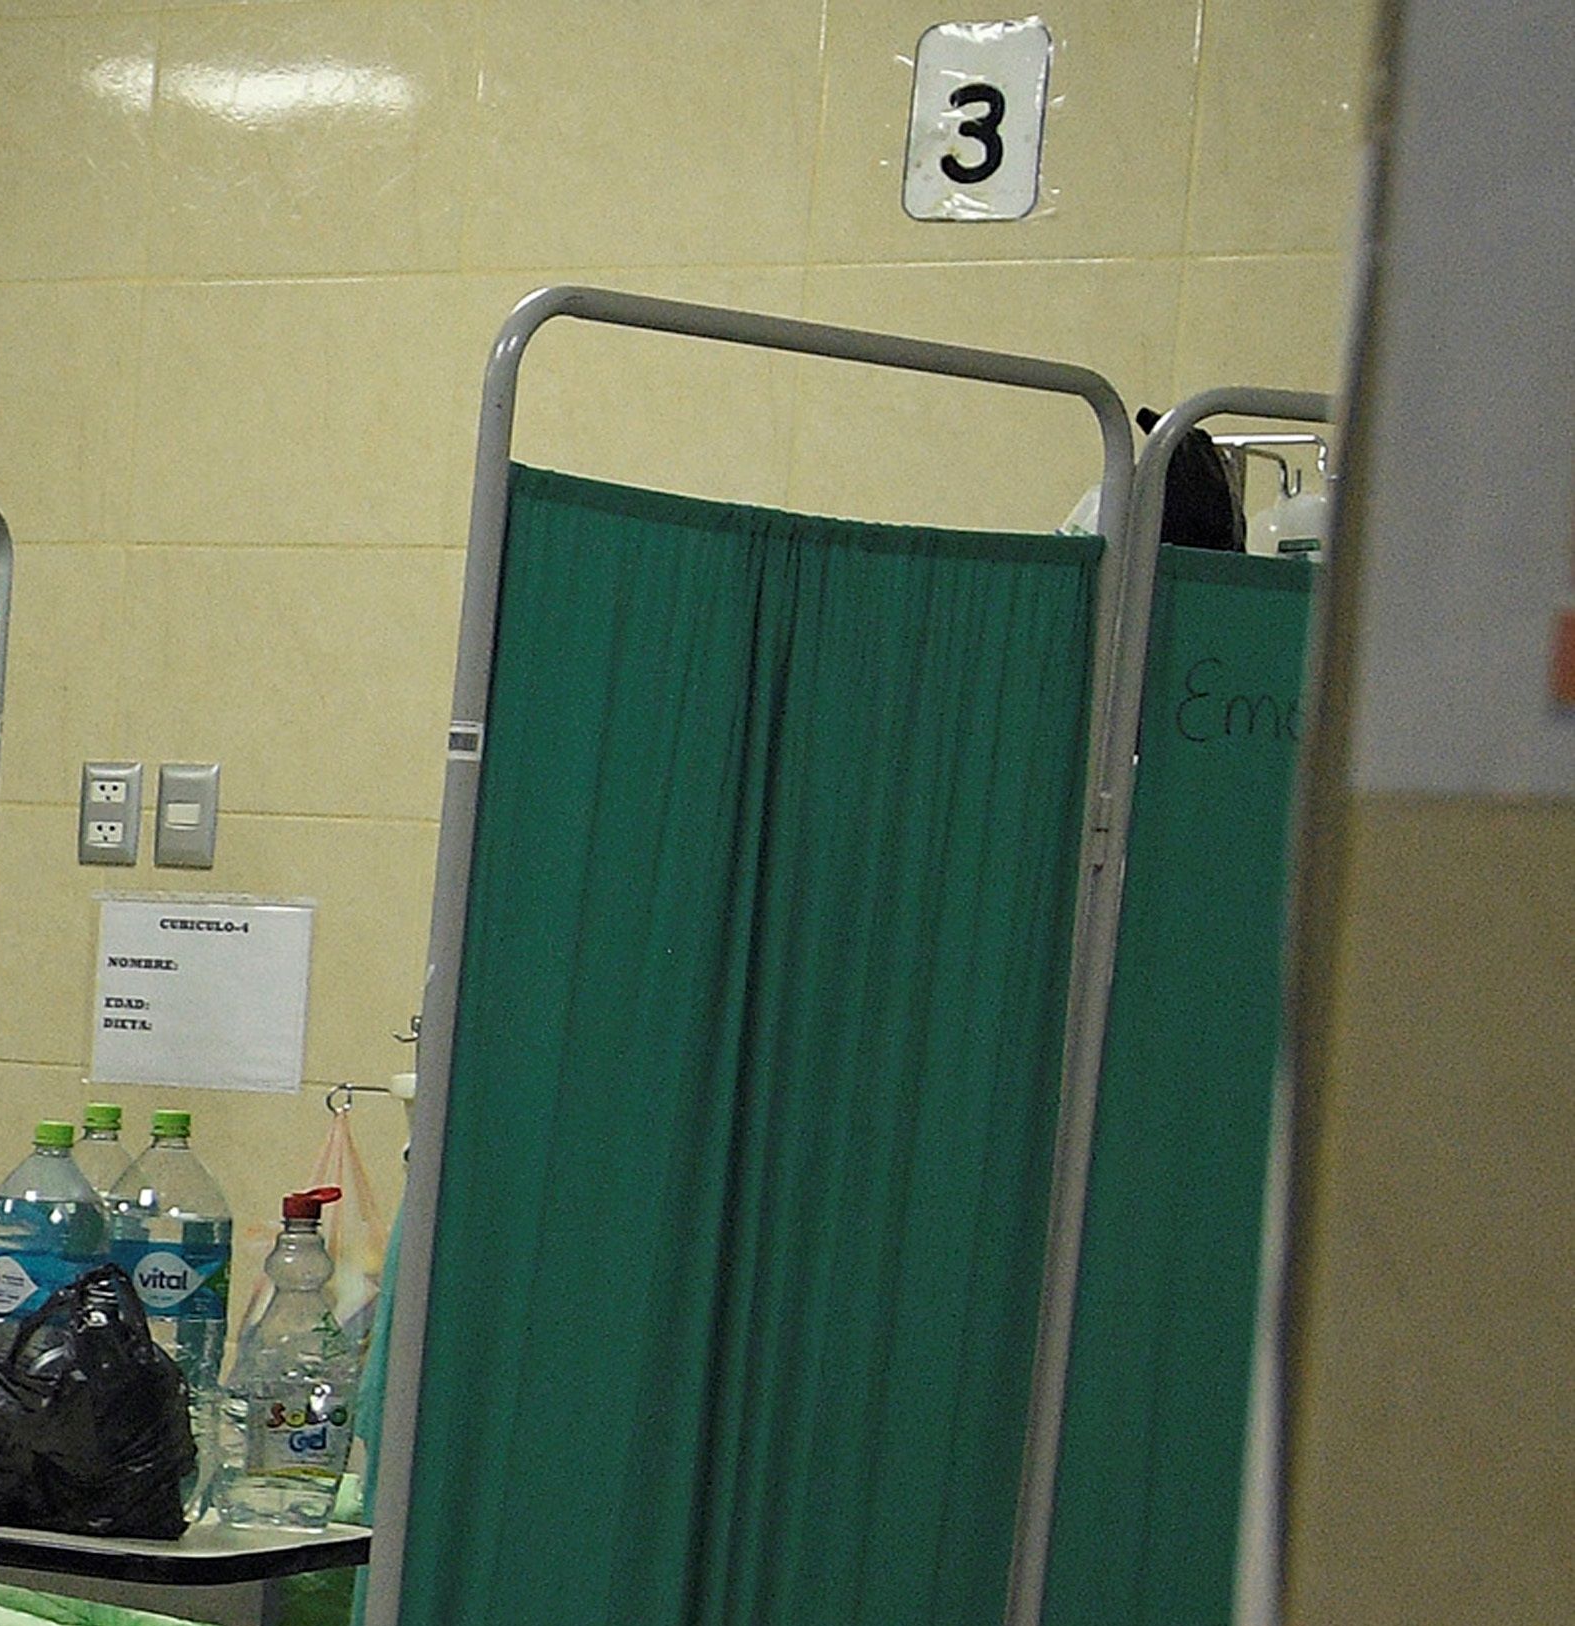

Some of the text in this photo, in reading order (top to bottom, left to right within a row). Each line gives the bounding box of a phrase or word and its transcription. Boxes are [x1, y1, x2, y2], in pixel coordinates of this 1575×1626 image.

[940, 83, 1005, 184] 3
[107, 956, 179, 971] NOMBRE:
[105, 996, 150, 1010] EDAD:
[138, 1266, 188, 1291] vital
